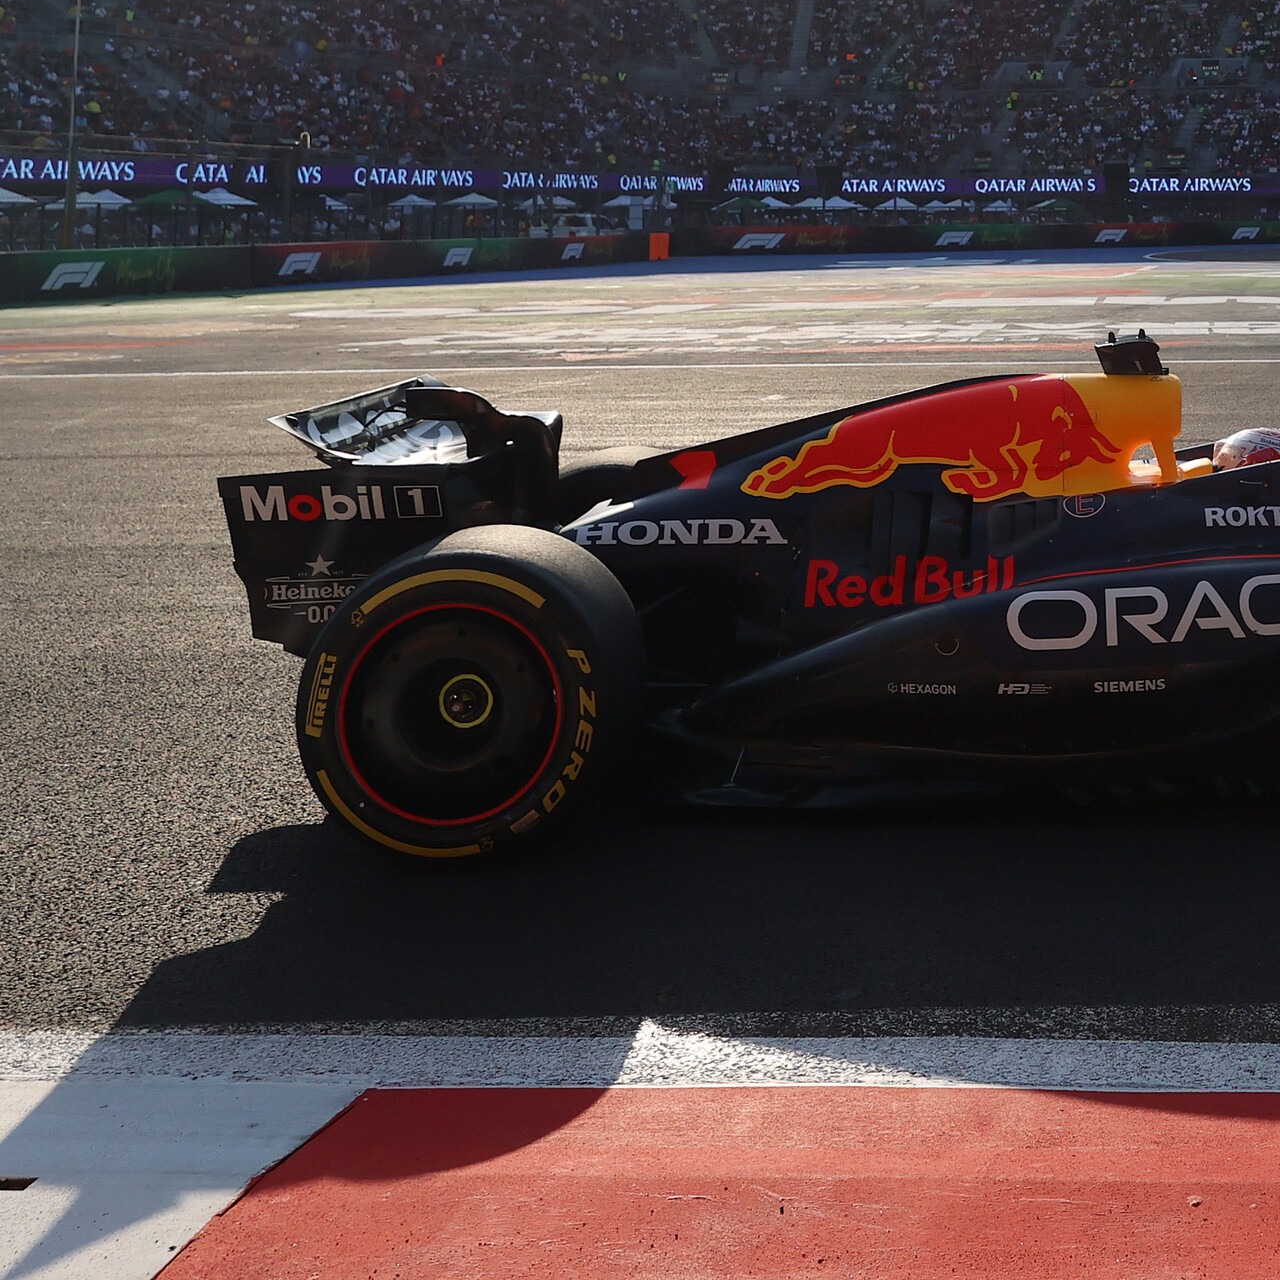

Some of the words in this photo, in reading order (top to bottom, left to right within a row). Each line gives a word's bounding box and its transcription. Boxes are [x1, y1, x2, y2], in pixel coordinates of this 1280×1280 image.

[882, 179, 946, 193] AIRWAYS
[975, 179, 1026, 194] QATAR
[1184, 178, 1252, 192] AIRWAYS
[732, 233, 786, 249] F1
[40, 261, 106, 291] F1
[239, 485, 386, 522] Mobil
[406, 487, 426, 517] 1
[573, 518, 788, 546] HONDA
[803, 554, 909, 609] Red
[914, 553, 1016, 606] Bull
[305, 652, 338, 738] PIRELLI
[900, 683, 957, 696] HEXAGON
[1093, 678, 1166, 694] SIEMENS
[541, 685, 598, 814] ZERO
